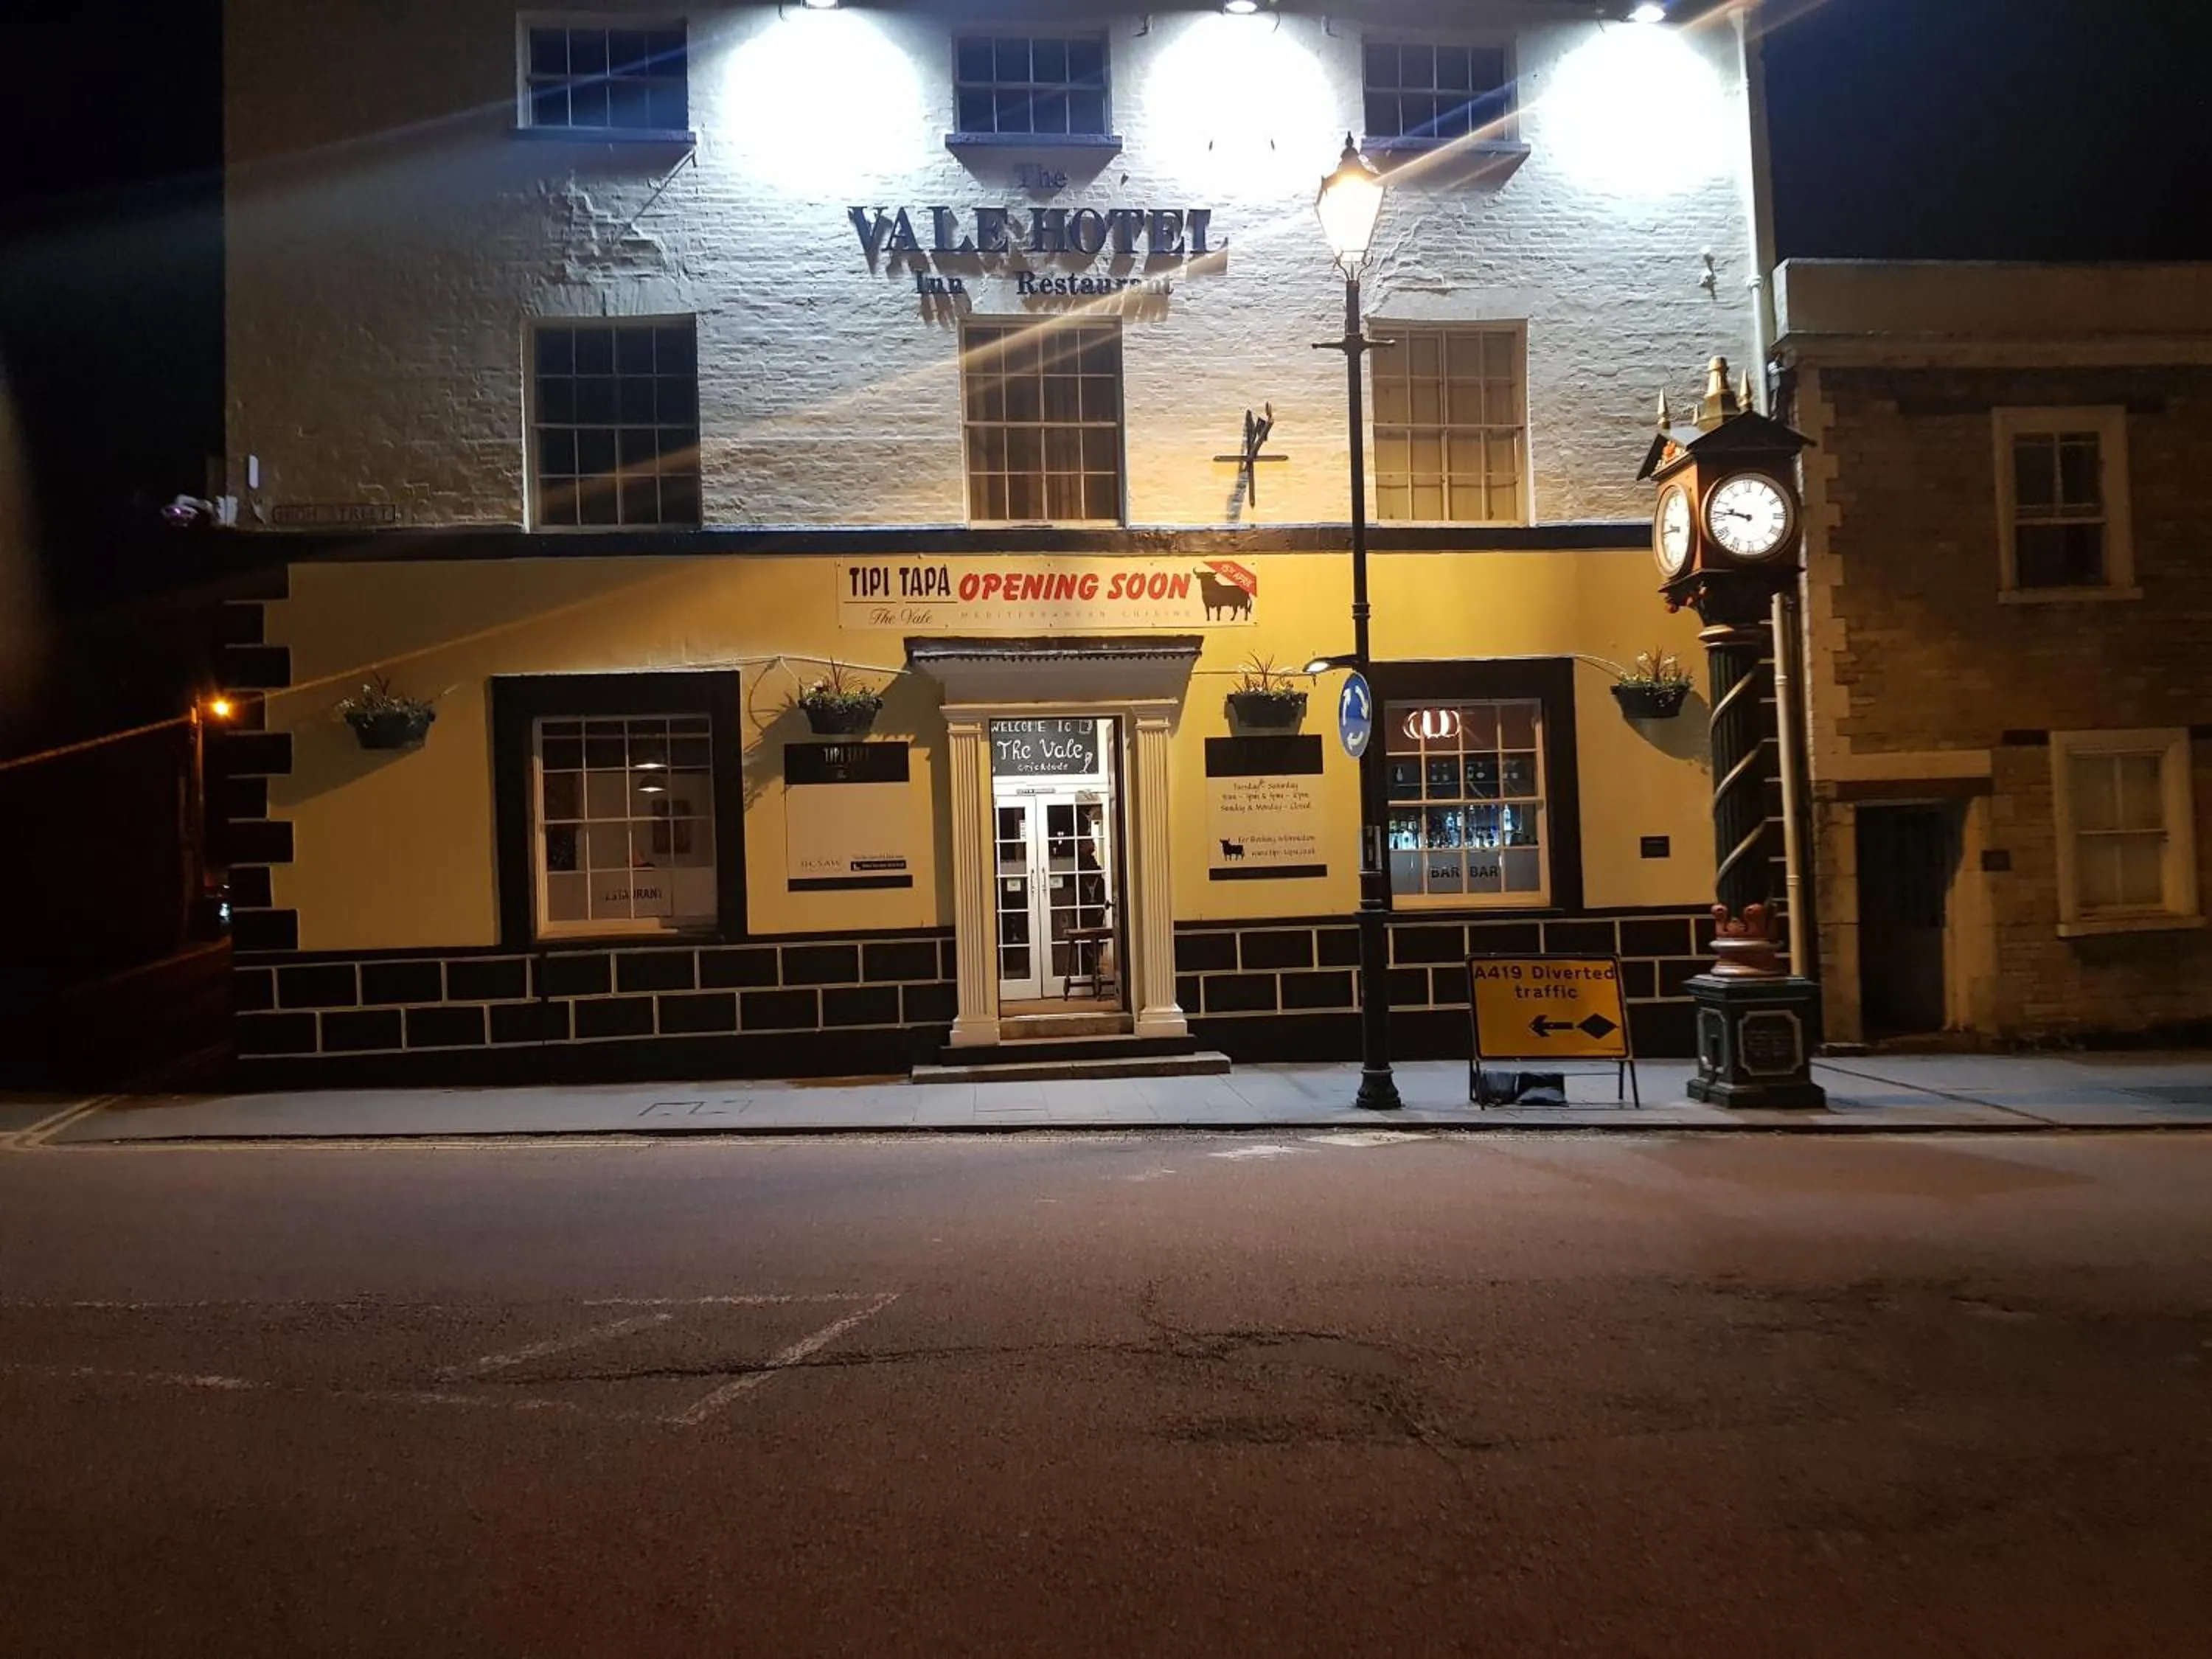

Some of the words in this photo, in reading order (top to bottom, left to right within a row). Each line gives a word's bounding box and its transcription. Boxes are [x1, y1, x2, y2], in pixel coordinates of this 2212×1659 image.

[1014, 164, 1068, 189] The
[848, 206, 1009, 254] VALE
[1028, 207, 1228, 254] HOTEL
[914, 270, 963, 295] Inn
[1015, 270, 1174, 295] Restaurant
[849, 566, 890, 597] TIPI
[899, 566, 951, 597] TAPA
[959, 573, 1099, 601] OPENING
[1107, 572, 1192, 599] SOON
[869, 608, 896, 625] The
[900, 607, 933, 625] Vale
[996, 740, 1032, 760] The
[1039, 738, 1083, 759] Vale
[1431, 866, 1460, 878] BAR
[1470, 866, 1498, 877] BAR
[1474, 965, 1522, 979] A419
[1532, 967, 1615, 980] Diverted
[1515, 985, 1578, 998] traffic
